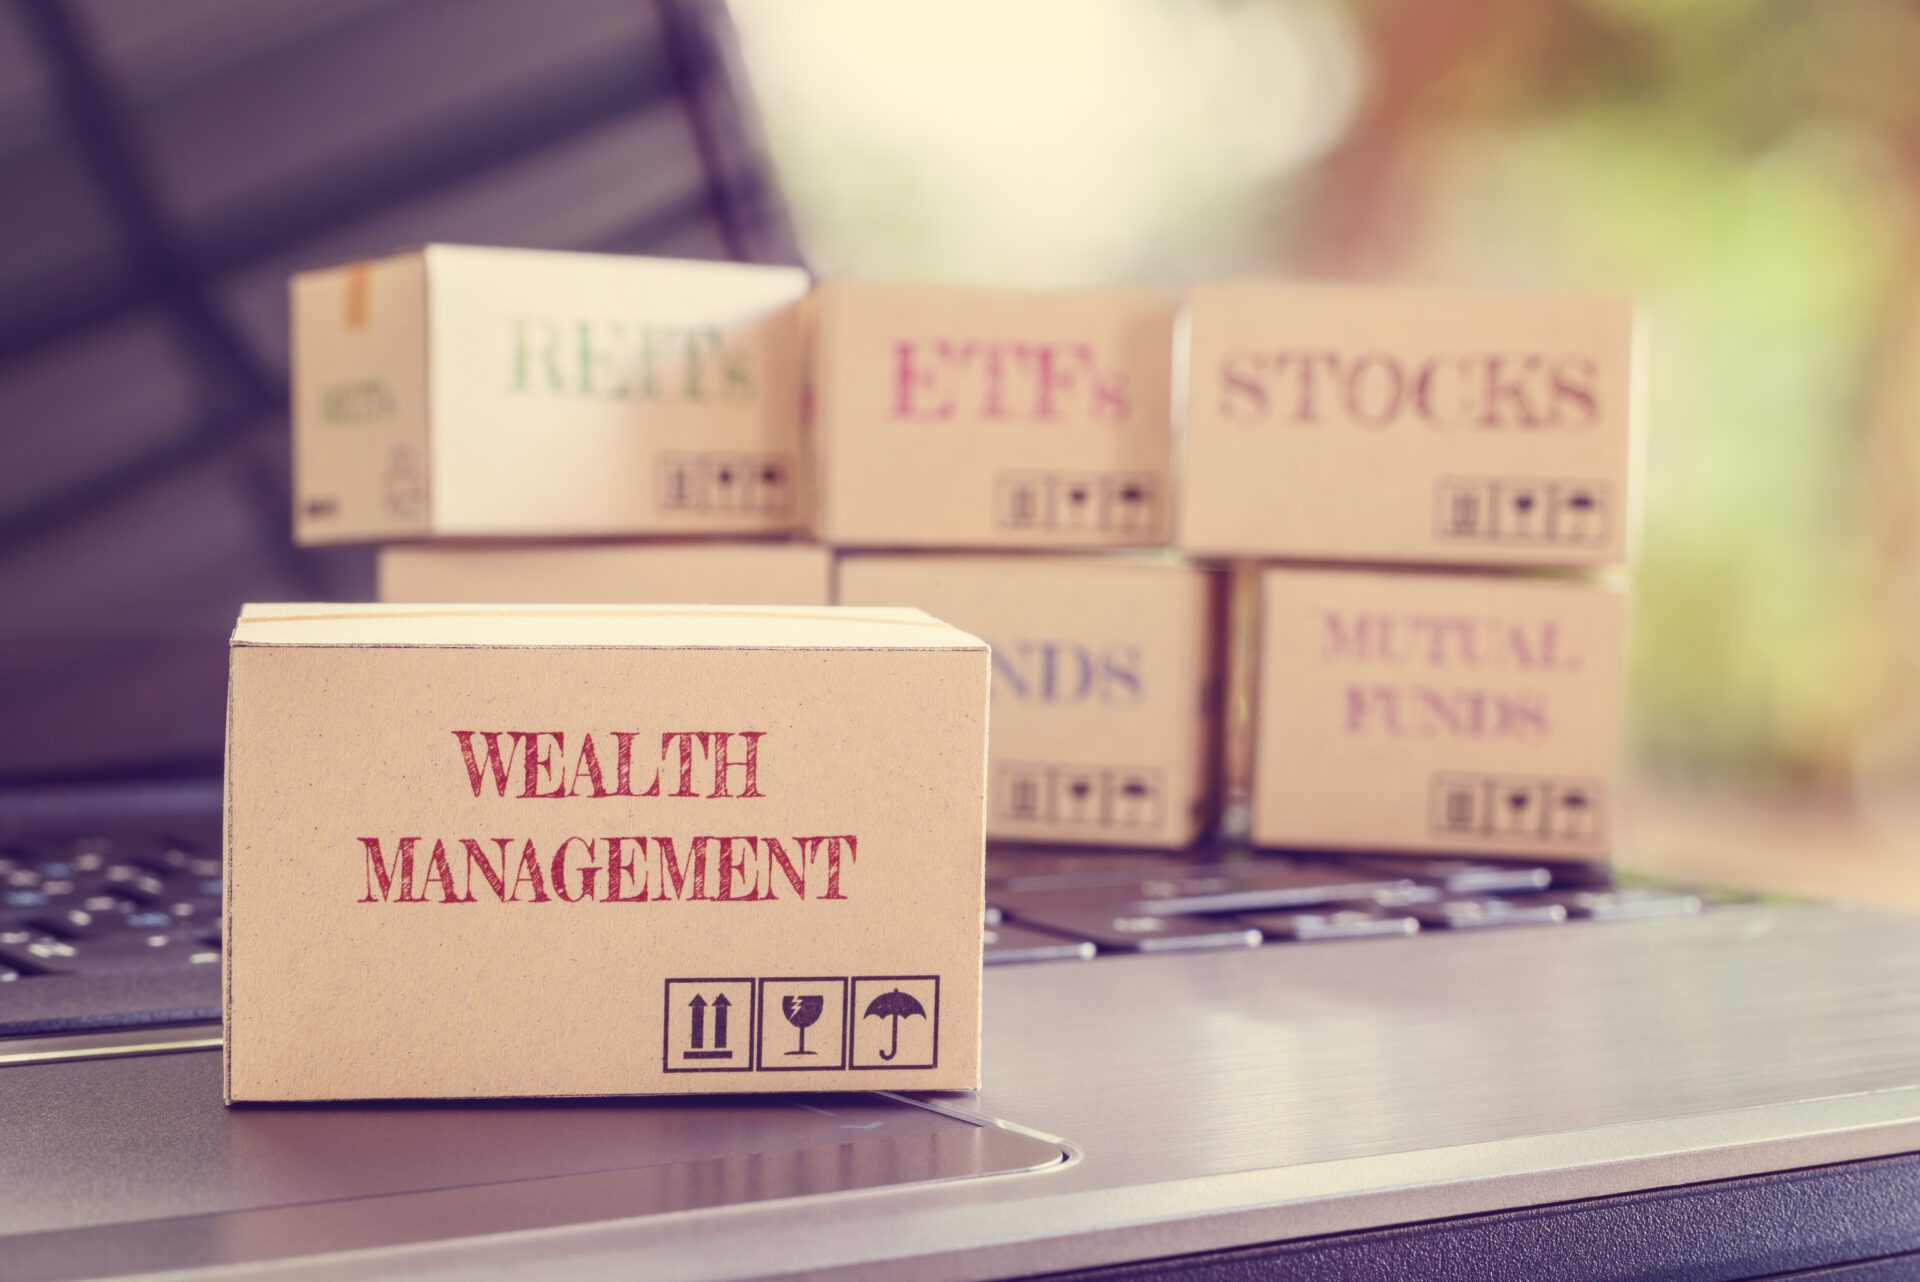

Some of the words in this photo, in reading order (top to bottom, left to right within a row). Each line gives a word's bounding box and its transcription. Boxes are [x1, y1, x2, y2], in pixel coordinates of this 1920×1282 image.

[509, 316, 757, 403] REITs
[889, 339, 1131, 424] ETFs
[1217, 349, 1601, 431] STOCKS
[990, 641, 1147, 706] NDS
[1321, 611, 1583, 673] MUTUAL
[1344, 686, 1550, 738] FUNDS
[451, 731, 767, 798] WEALTH
[357, 835, 858, 904] MANAGEMENT
